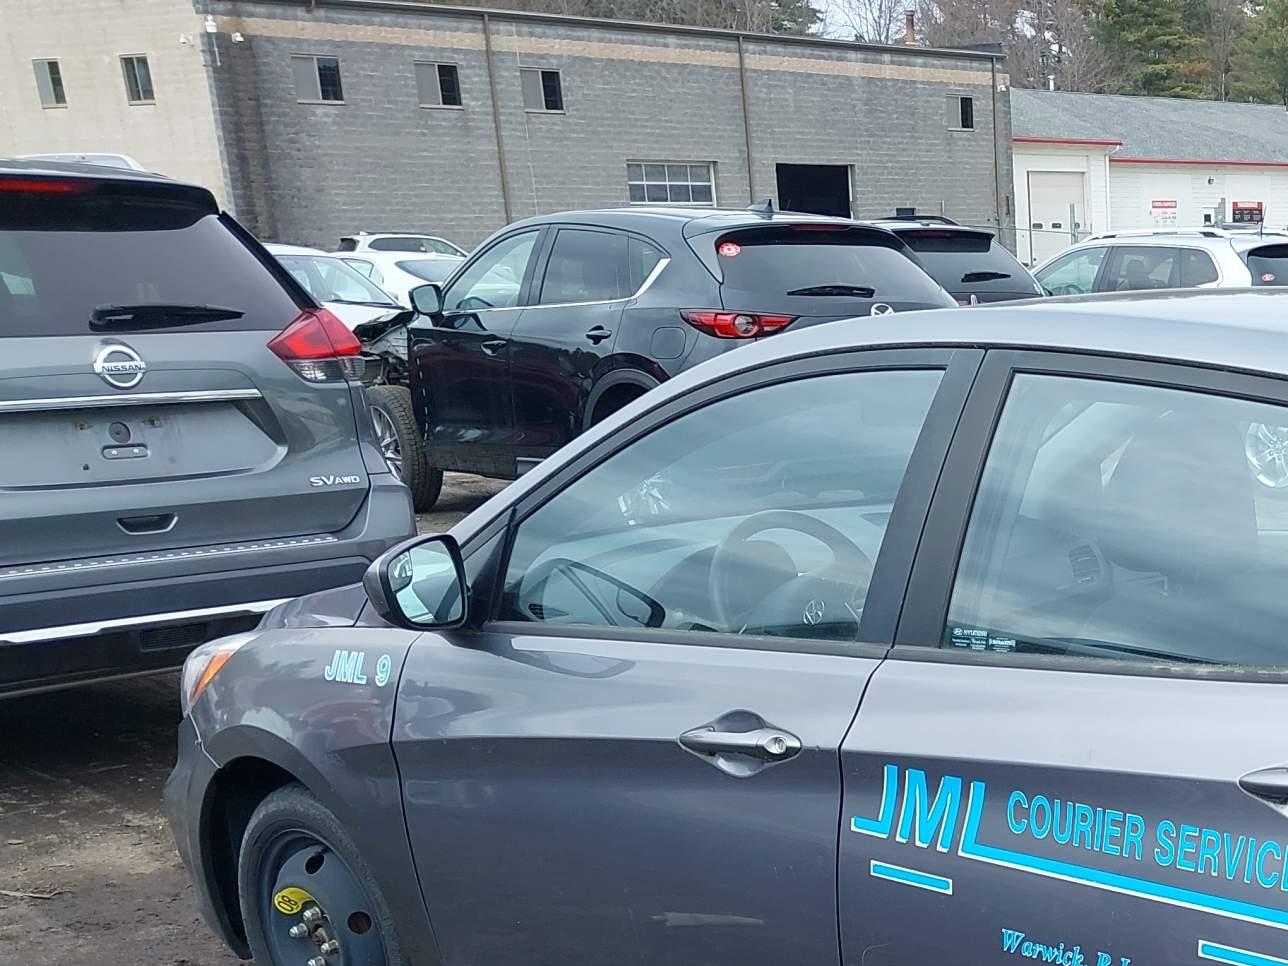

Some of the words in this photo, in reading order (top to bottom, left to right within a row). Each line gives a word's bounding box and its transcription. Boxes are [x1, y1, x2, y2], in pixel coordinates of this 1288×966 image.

[101, 363, 143, 373] NISSAN
[309, 475, 334, 487] SV
[335, 475, 360, 485] AWD
[324, 649, 367, 685] JML
[375, 654, 392, 687] 9
[850, 763, 986, 857] JML
[1006, 790, 1145, 860] COURIER
